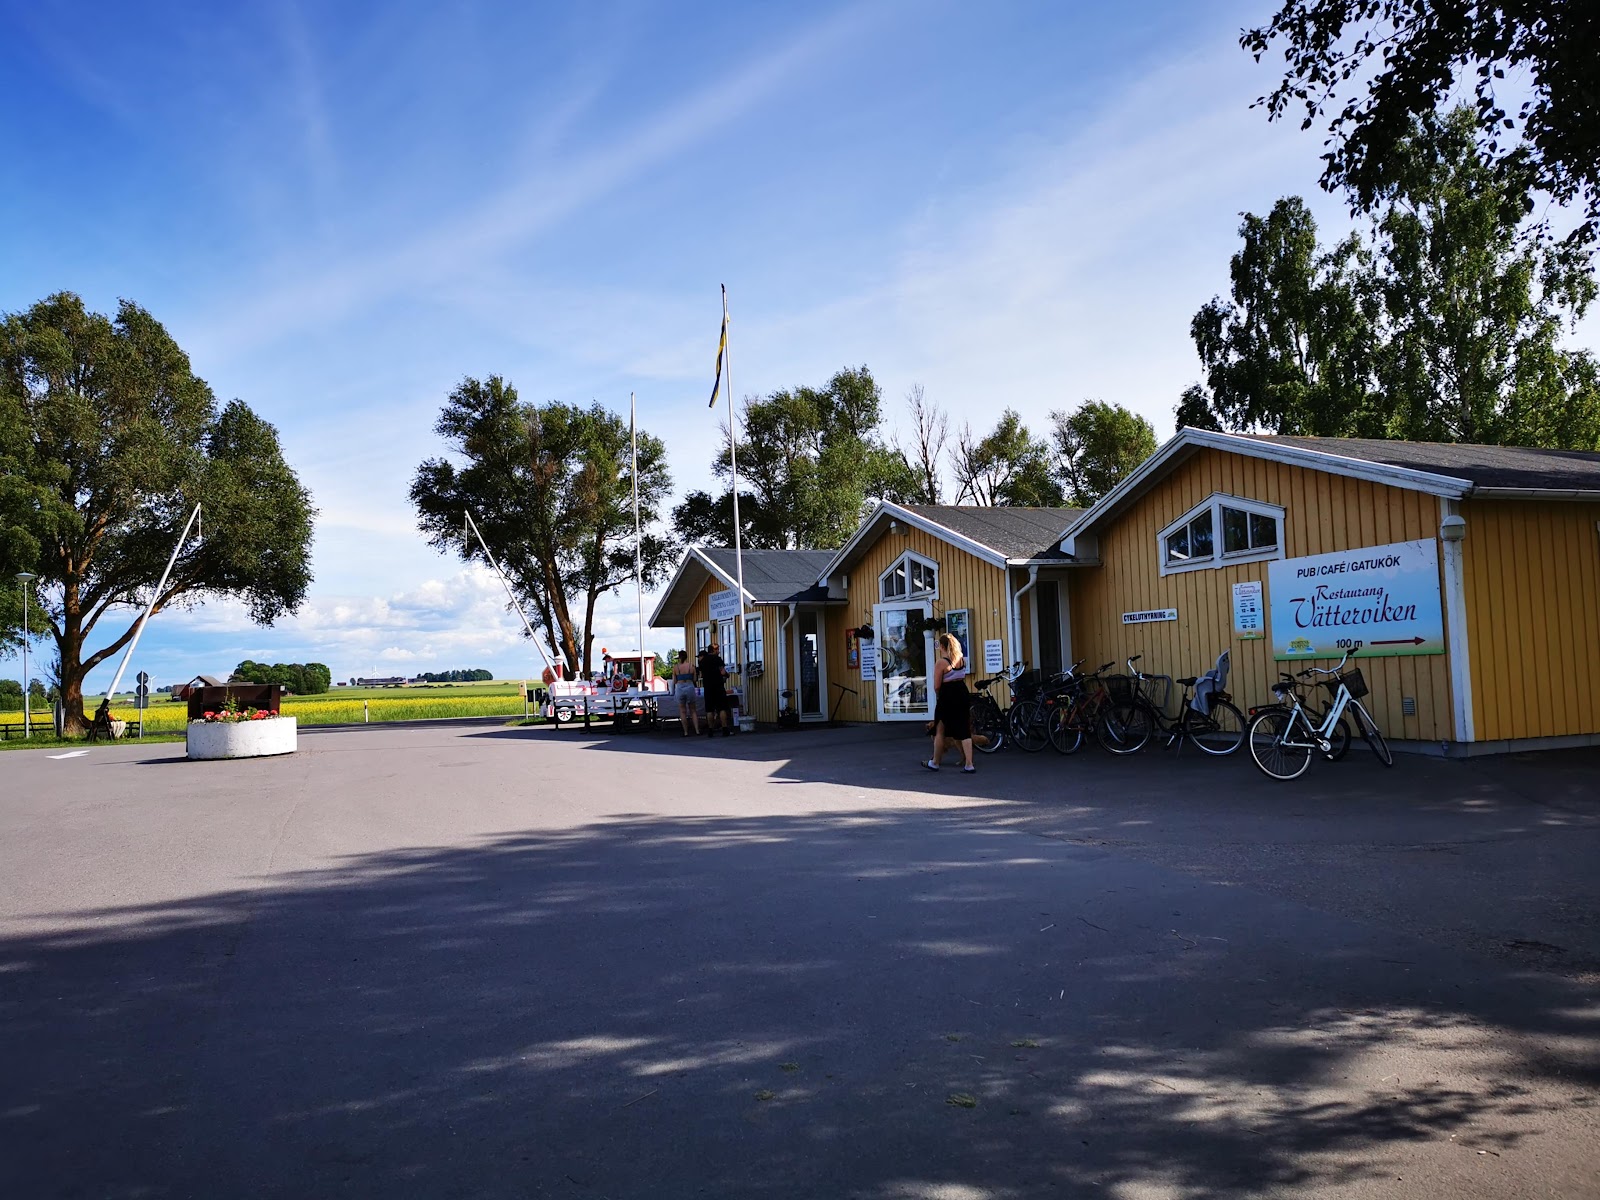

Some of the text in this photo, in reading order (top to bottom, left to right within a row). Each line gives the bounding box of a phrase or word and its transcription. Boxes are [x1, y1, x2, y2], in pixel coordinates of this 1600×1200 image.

[1315, 584, 1384, 601] Restaurang
[1123, 611, 1166, 622] CYKELUTHYRNING
[1289, 593, 1418, 628] Vätterviken
[1336, 639, 1363, 648] 100 m
